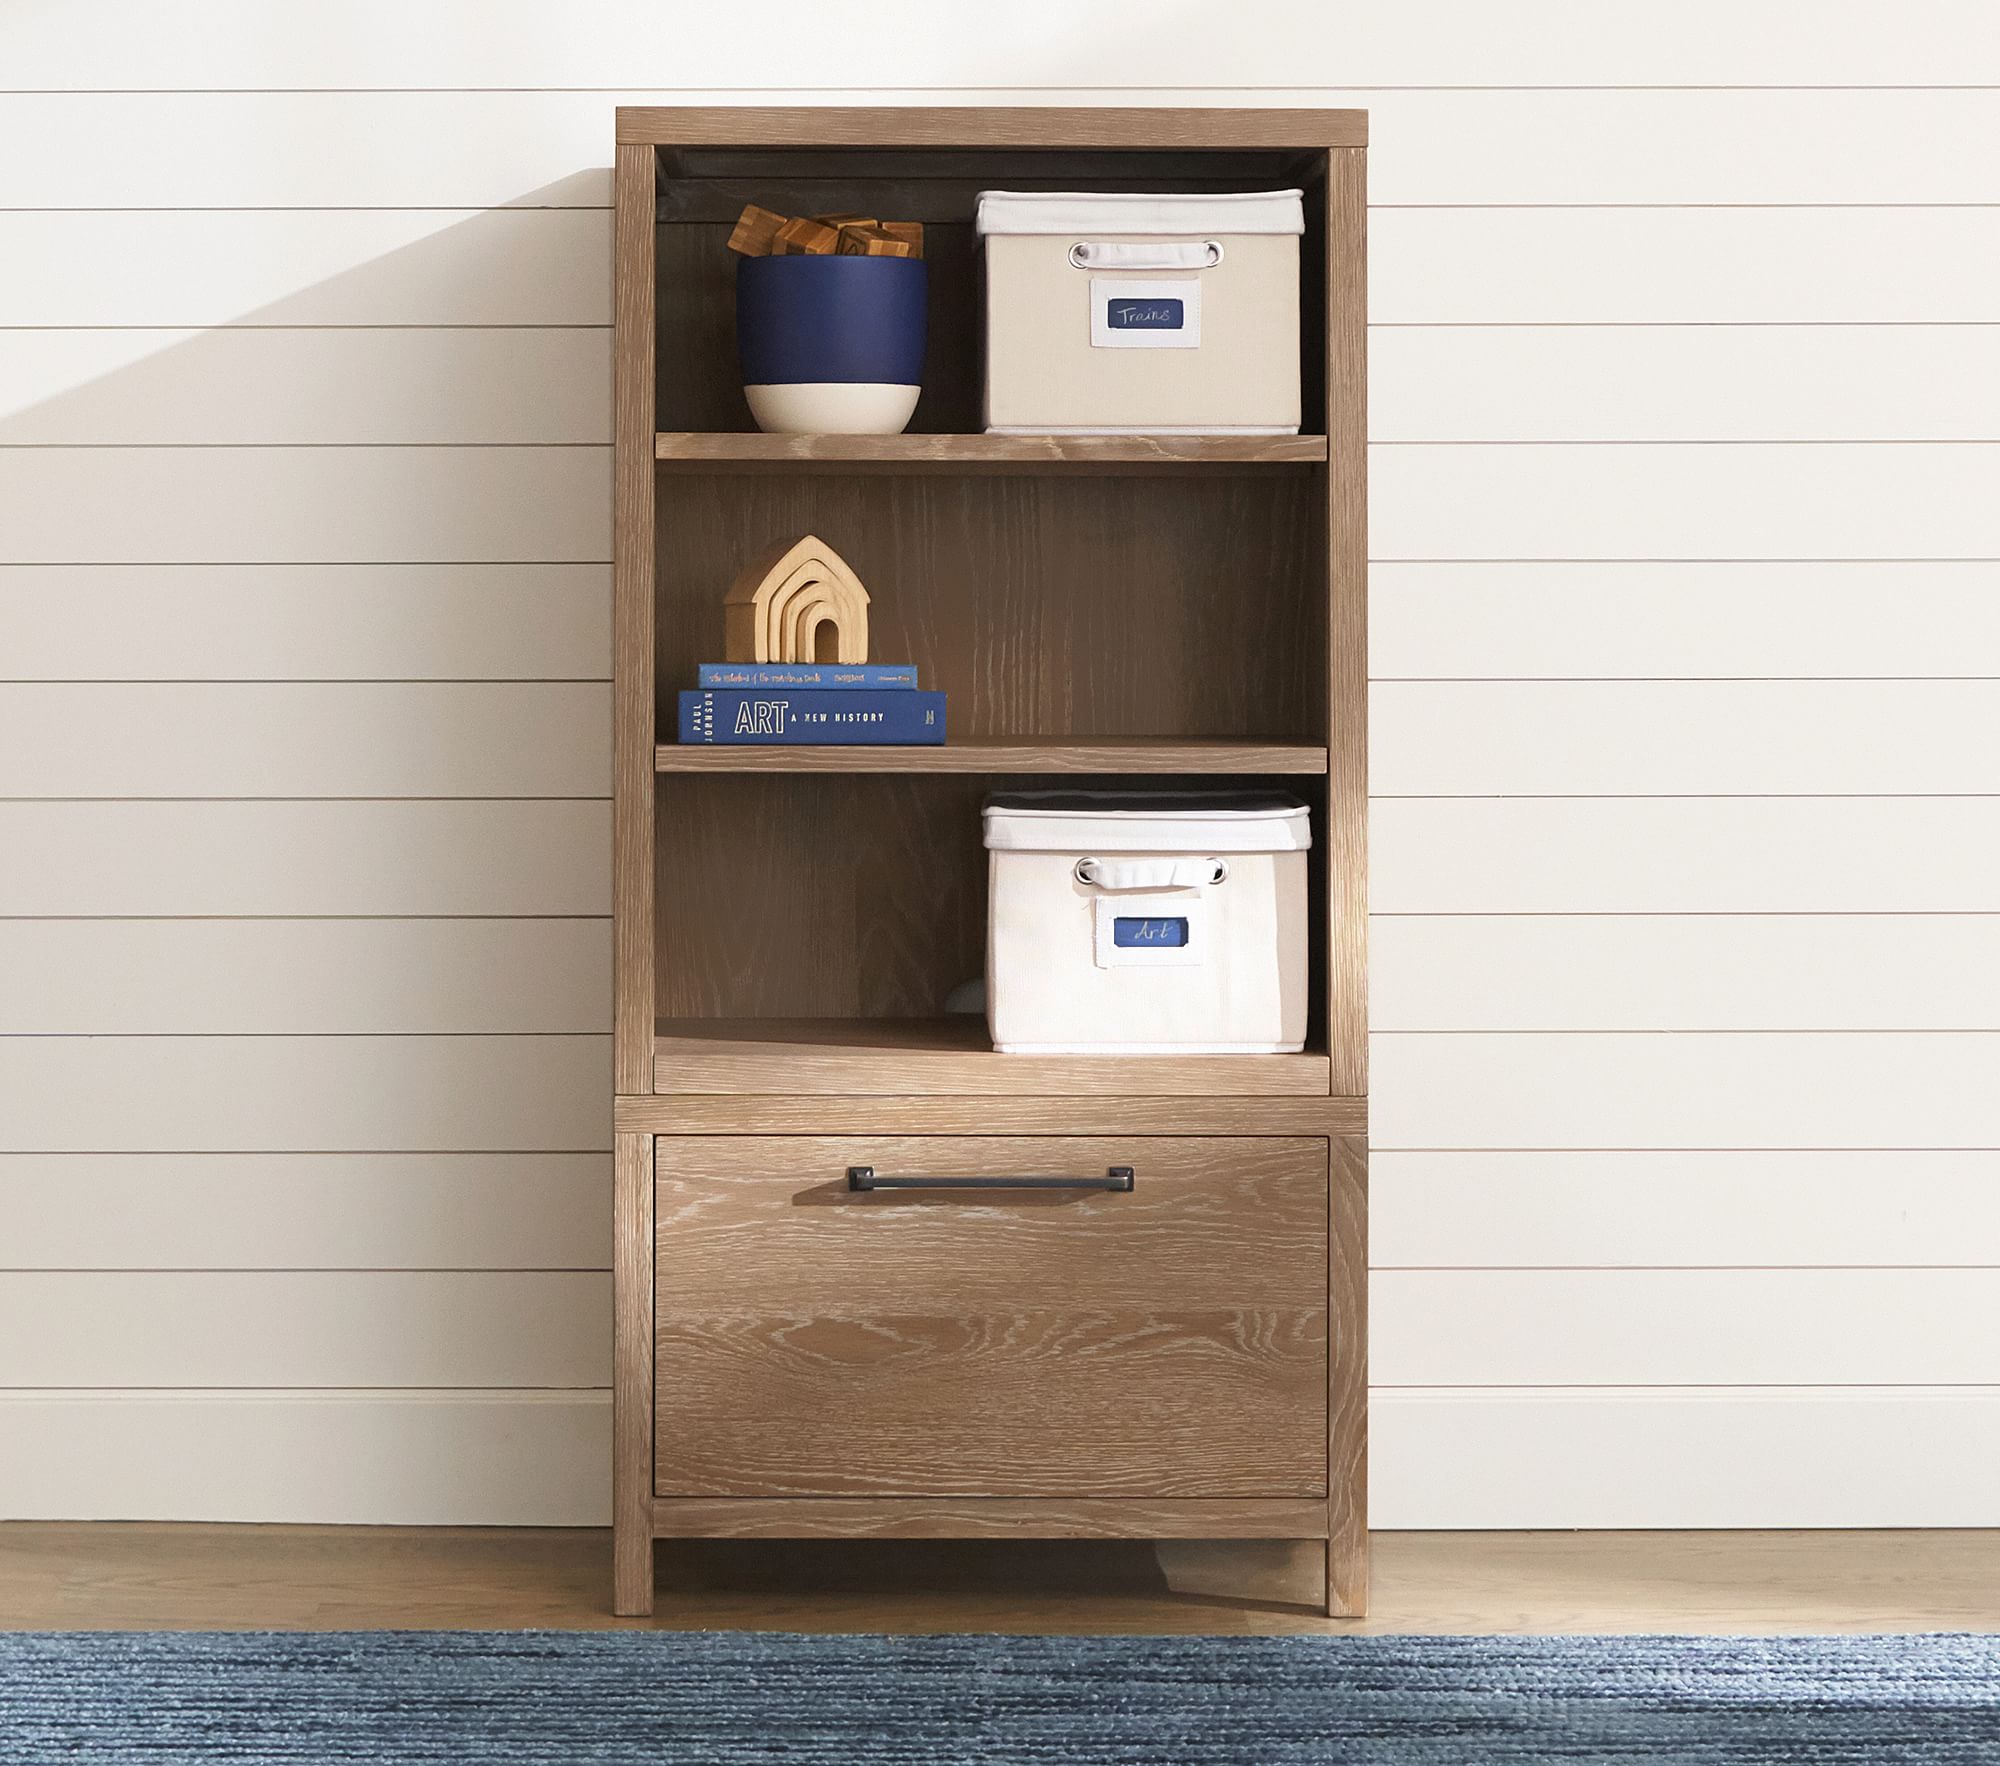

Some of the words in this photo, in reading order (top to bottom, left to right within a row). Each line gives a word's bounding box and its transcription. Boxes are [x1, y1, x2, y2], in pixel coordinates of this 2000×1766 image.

[1117, 307, 1170, 325] Trains
[693, 704, 702, 731] PAUL
[704, 693, 713, 742] JOHNSON
[734, 701, 788, 734] ART
[791, 713, 797, 722] A
[804, 713, 827, 722] NEW
[835, 713, 884, 722] HISTORY
[1134, 921, 1173, 939] Art
